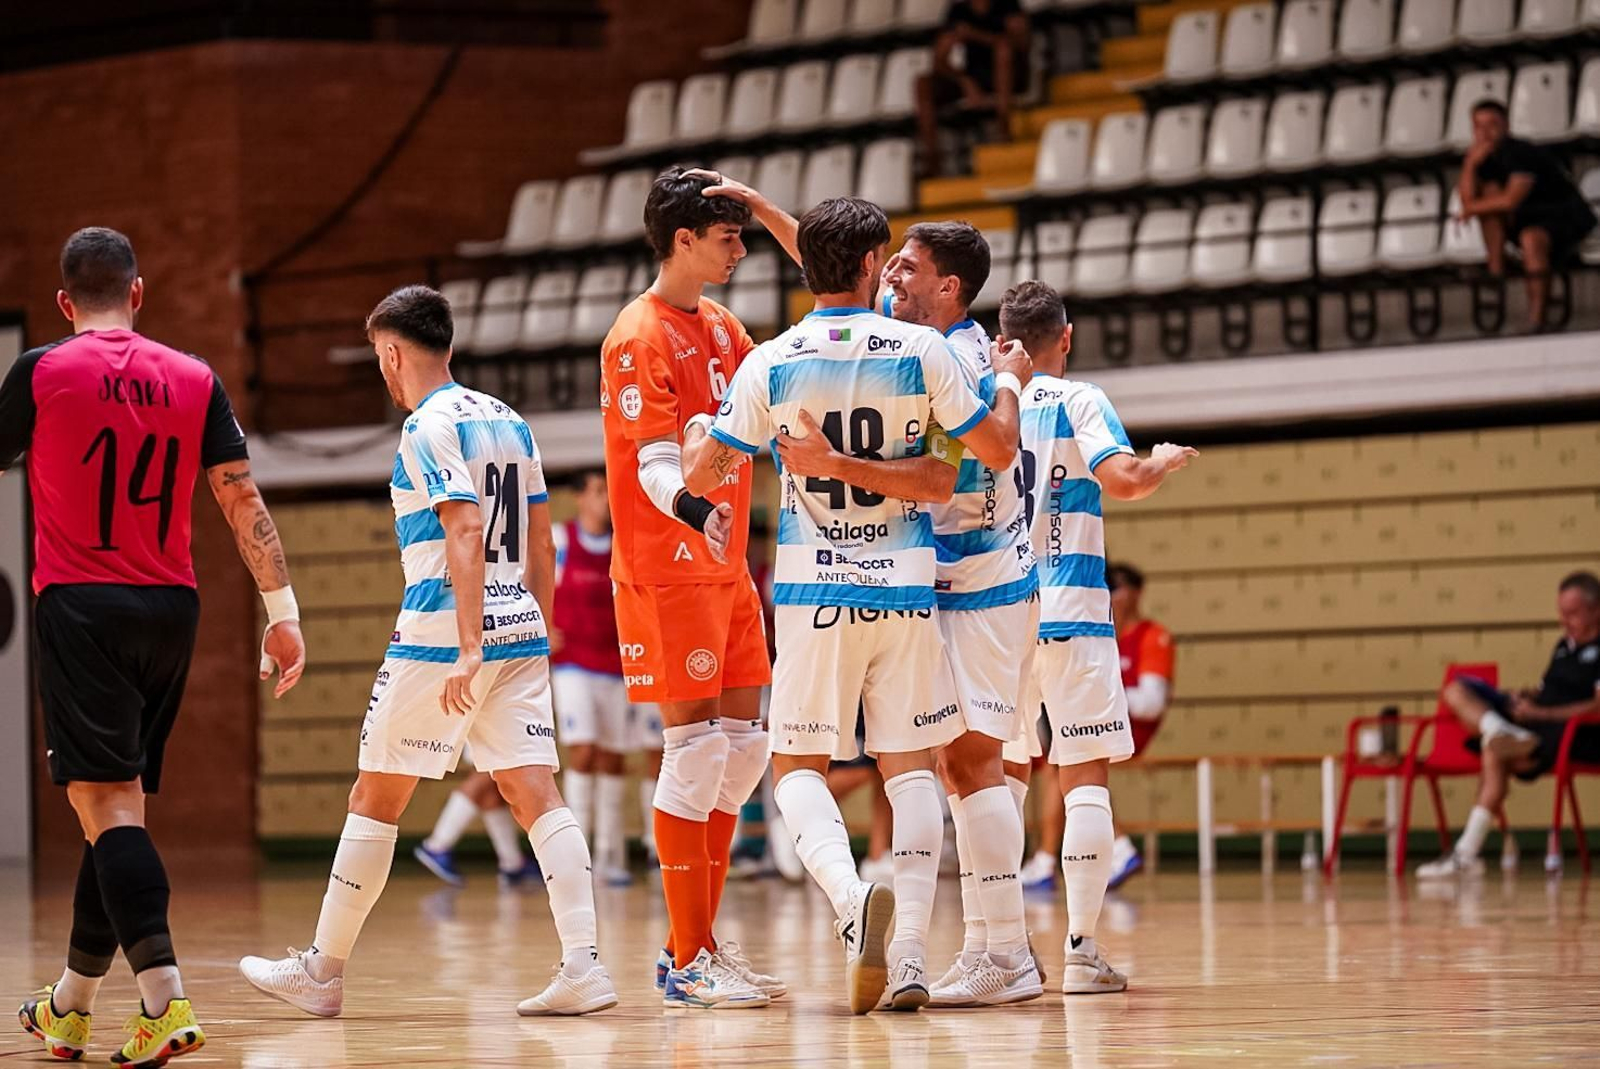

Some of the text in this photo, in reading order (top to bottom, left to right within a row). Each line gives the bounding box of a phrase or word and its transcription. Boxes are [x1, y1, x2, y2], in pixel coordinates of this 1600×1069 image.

[82, 426, 180, 556] 14
[484, 462, 520, 563] 21
[1060, 720, 1125, 738] Cómpeta
